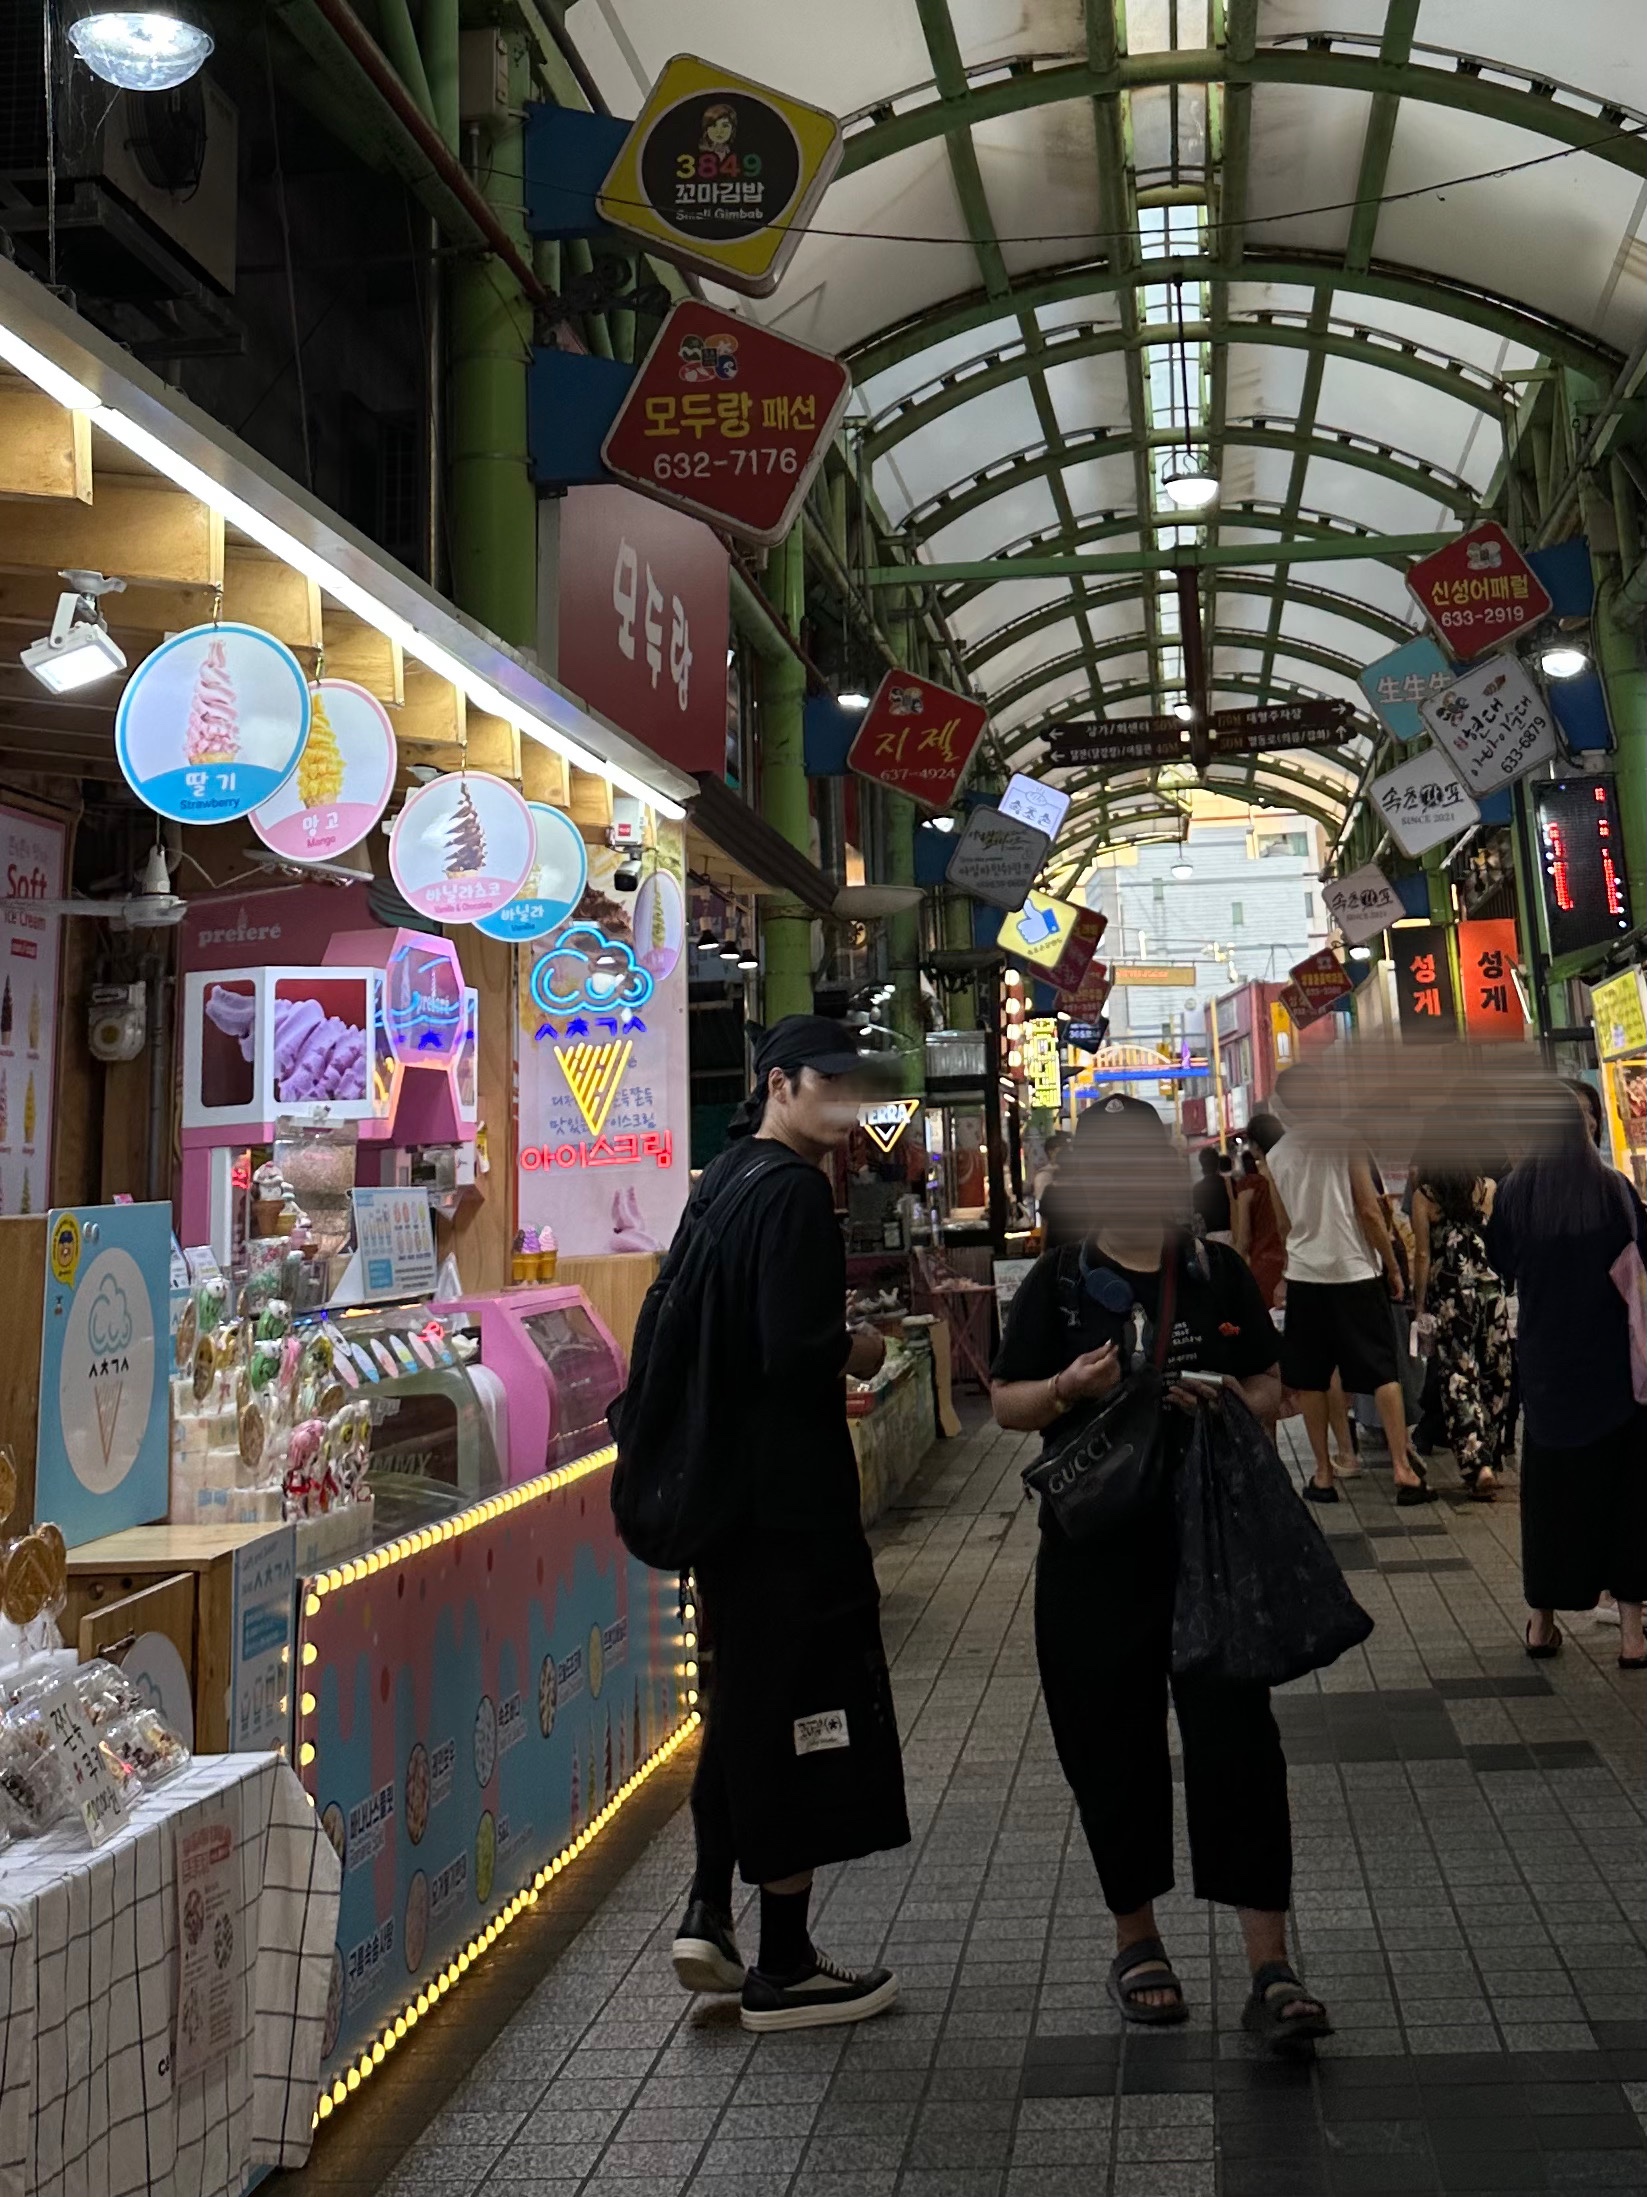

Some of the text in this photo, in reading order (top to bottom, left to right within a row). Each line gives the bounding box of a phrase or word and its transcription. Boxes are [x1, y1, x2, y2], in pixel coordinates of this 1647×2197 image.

[676, 154, 763, 179] 3849
[675, 181, 765, 204] 꼬마김밥
[714, 207, 764, 220] Gimbab
[644, 391, 816, 439] 모두랑 패션
[654, 448, 798, 479] 632-7176
[1431, 573, 1529, 606] 신성어패럴
[1441, 605, 1525, 627] 633-2919
[1463, 697, 1504, 740] 현대
[1471, 695, 1533, 777] 아바이순대
[1500, 715, 1547, 774] 633-6879
[185, 771, 236, 797] 딸기
[881, 768, 957, 781] 637-4924
[180, 797, 240, 810] Strawberry
[302, 812, 338, 836] 망고
[1401, 814, 1431, 825] SINCE
[307, 835, 337, 848] Mango
[7, 864, 47, 899] Soft
[501, 904, 545, 922] 바닐라
[1409, 953, 1442, 1017] 성게
[1478, 949, 1509, 1013] 성게
[520, 1129, 673, 1171] 아이스크림
[1049, 1432, 1112, 1494] GUCCI
